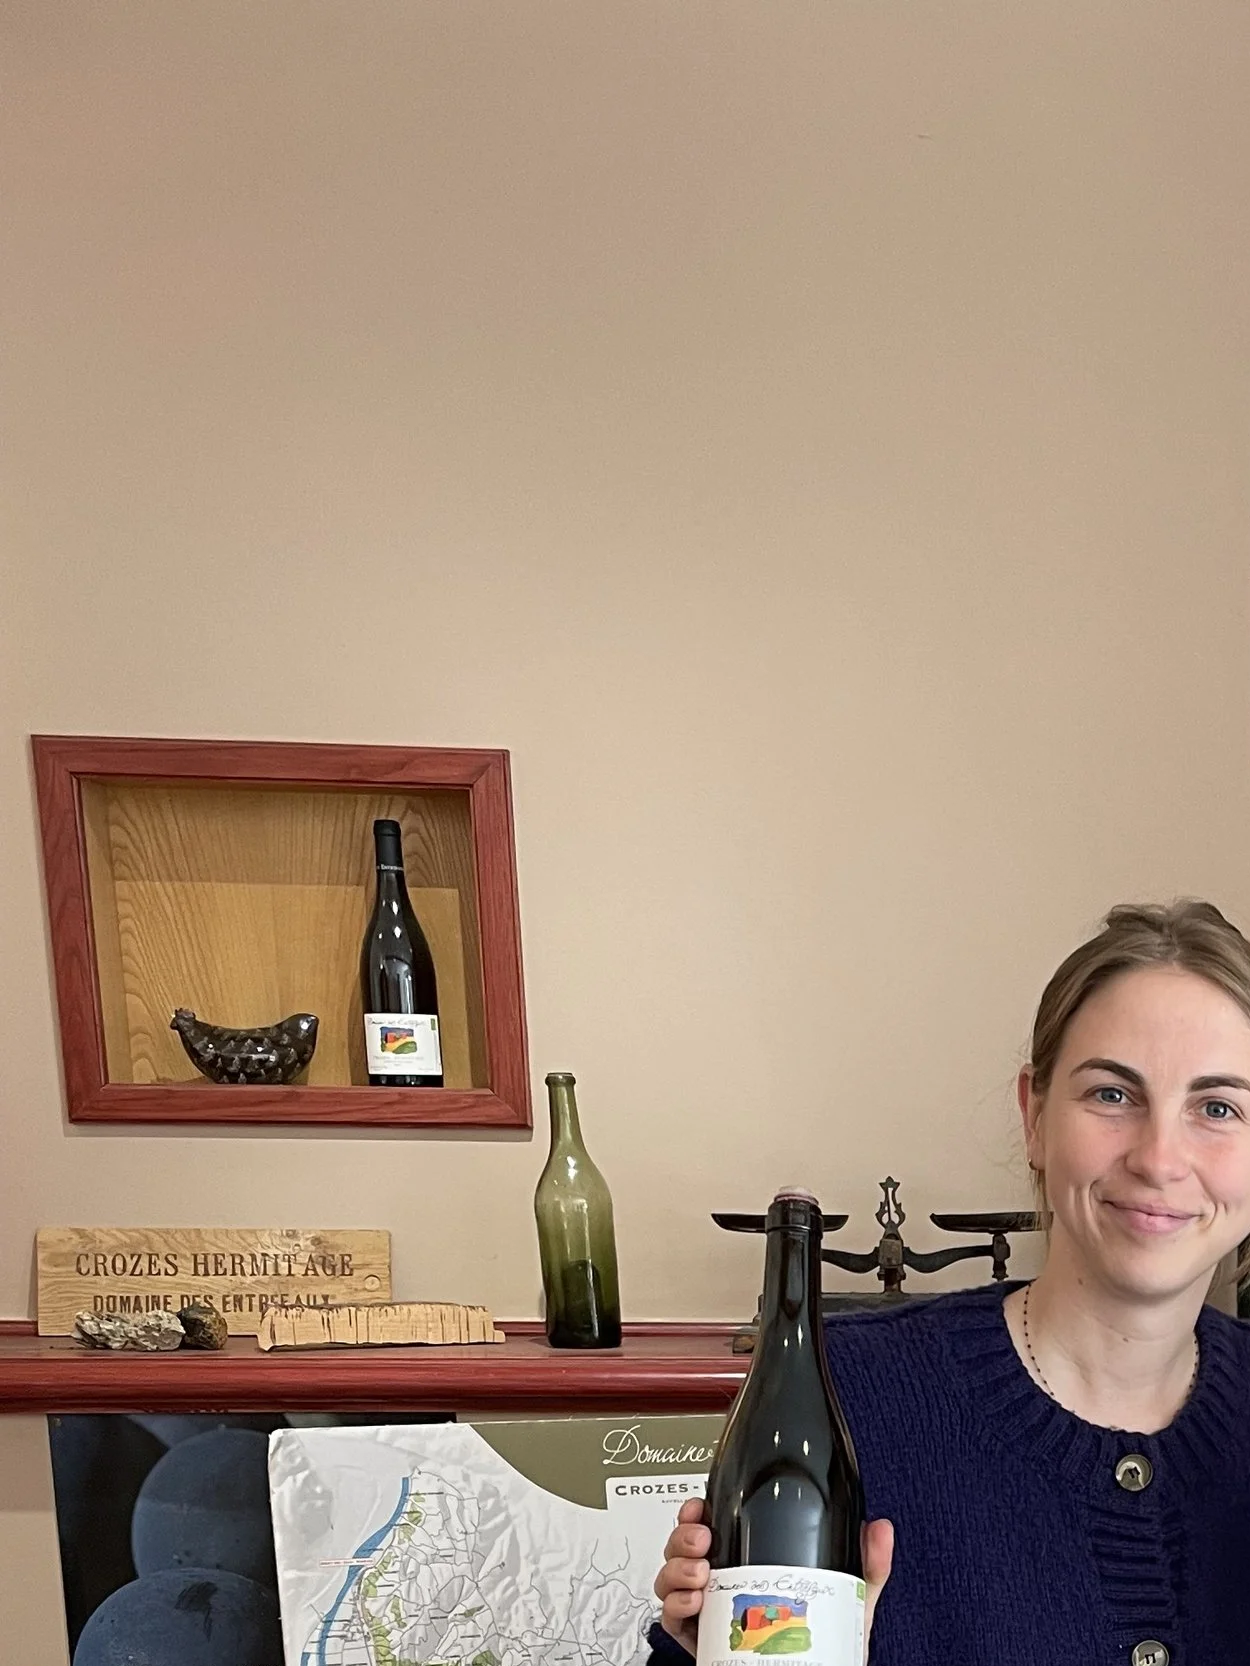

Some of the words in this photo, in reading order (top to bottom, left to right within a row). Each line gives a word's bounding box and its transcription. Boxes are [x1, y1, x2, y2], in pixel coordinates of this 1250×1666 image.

[75, 1253, 179, 1277] CROZES
[191, 1252, 355, 1277] HERMITAGE
[93, 1294, 172, 1314] DOMAINE
[602, 1424, 715, 1466] Domaine
[615, 1483, 688, 1496] CROZES
